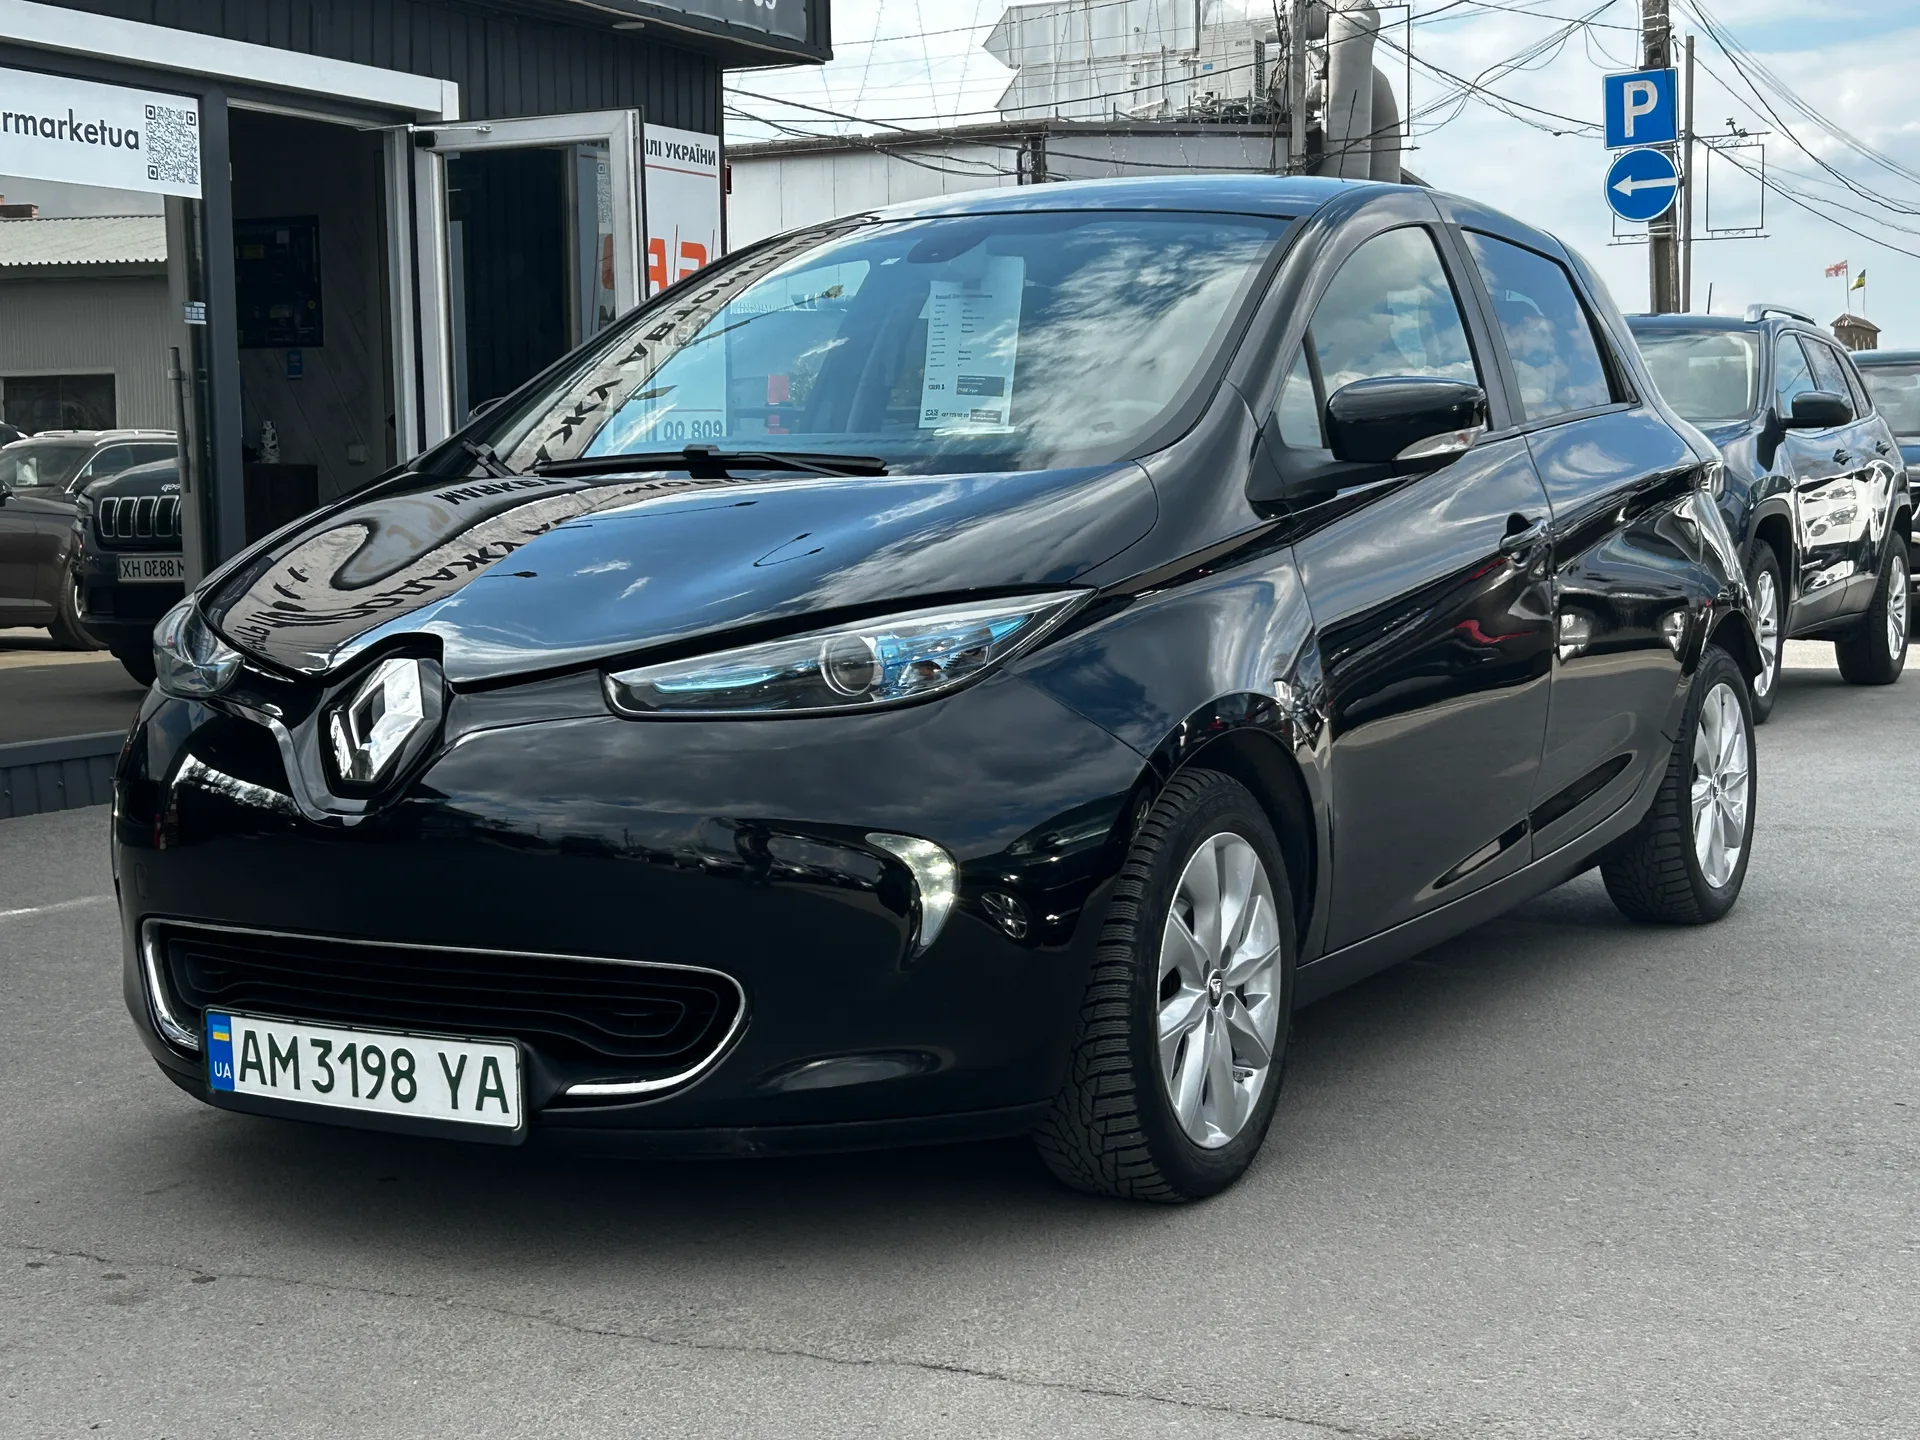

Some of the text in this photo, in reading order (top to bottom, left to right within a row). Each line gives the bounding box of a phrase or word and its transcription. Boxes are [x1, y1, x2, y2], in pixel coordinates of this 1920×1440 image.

[2, 108, 140, 150] rmarketua
[1623, 79, 1659, 139] P
[665, 142, 716, 166] УКРАЇНИ
[214, 1060, 232, 1080] UA
[238, 1029, 510, 1114] AM 3198 YA
